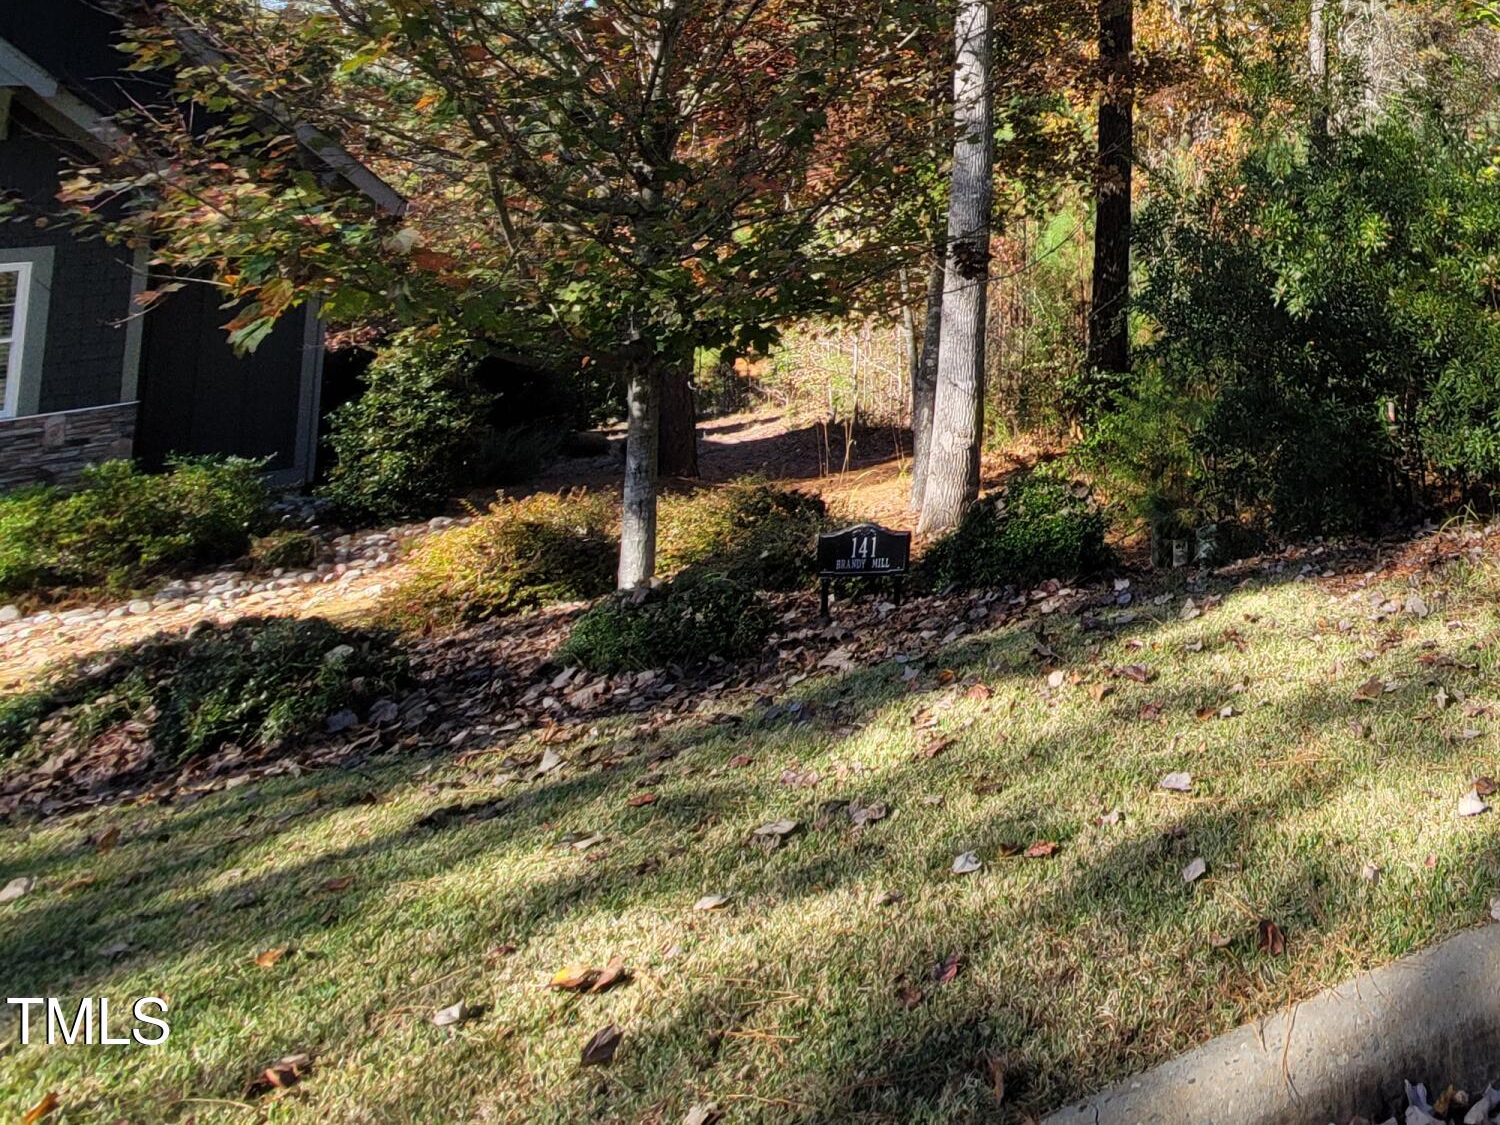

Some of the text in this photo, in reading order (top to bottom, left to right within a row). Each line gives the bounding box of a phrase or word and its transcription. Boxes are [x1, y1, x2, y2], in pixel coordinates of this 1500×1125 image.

[851, 536, 877, 558] 141
[836, 557, 890, 570] BRANDY MILL
